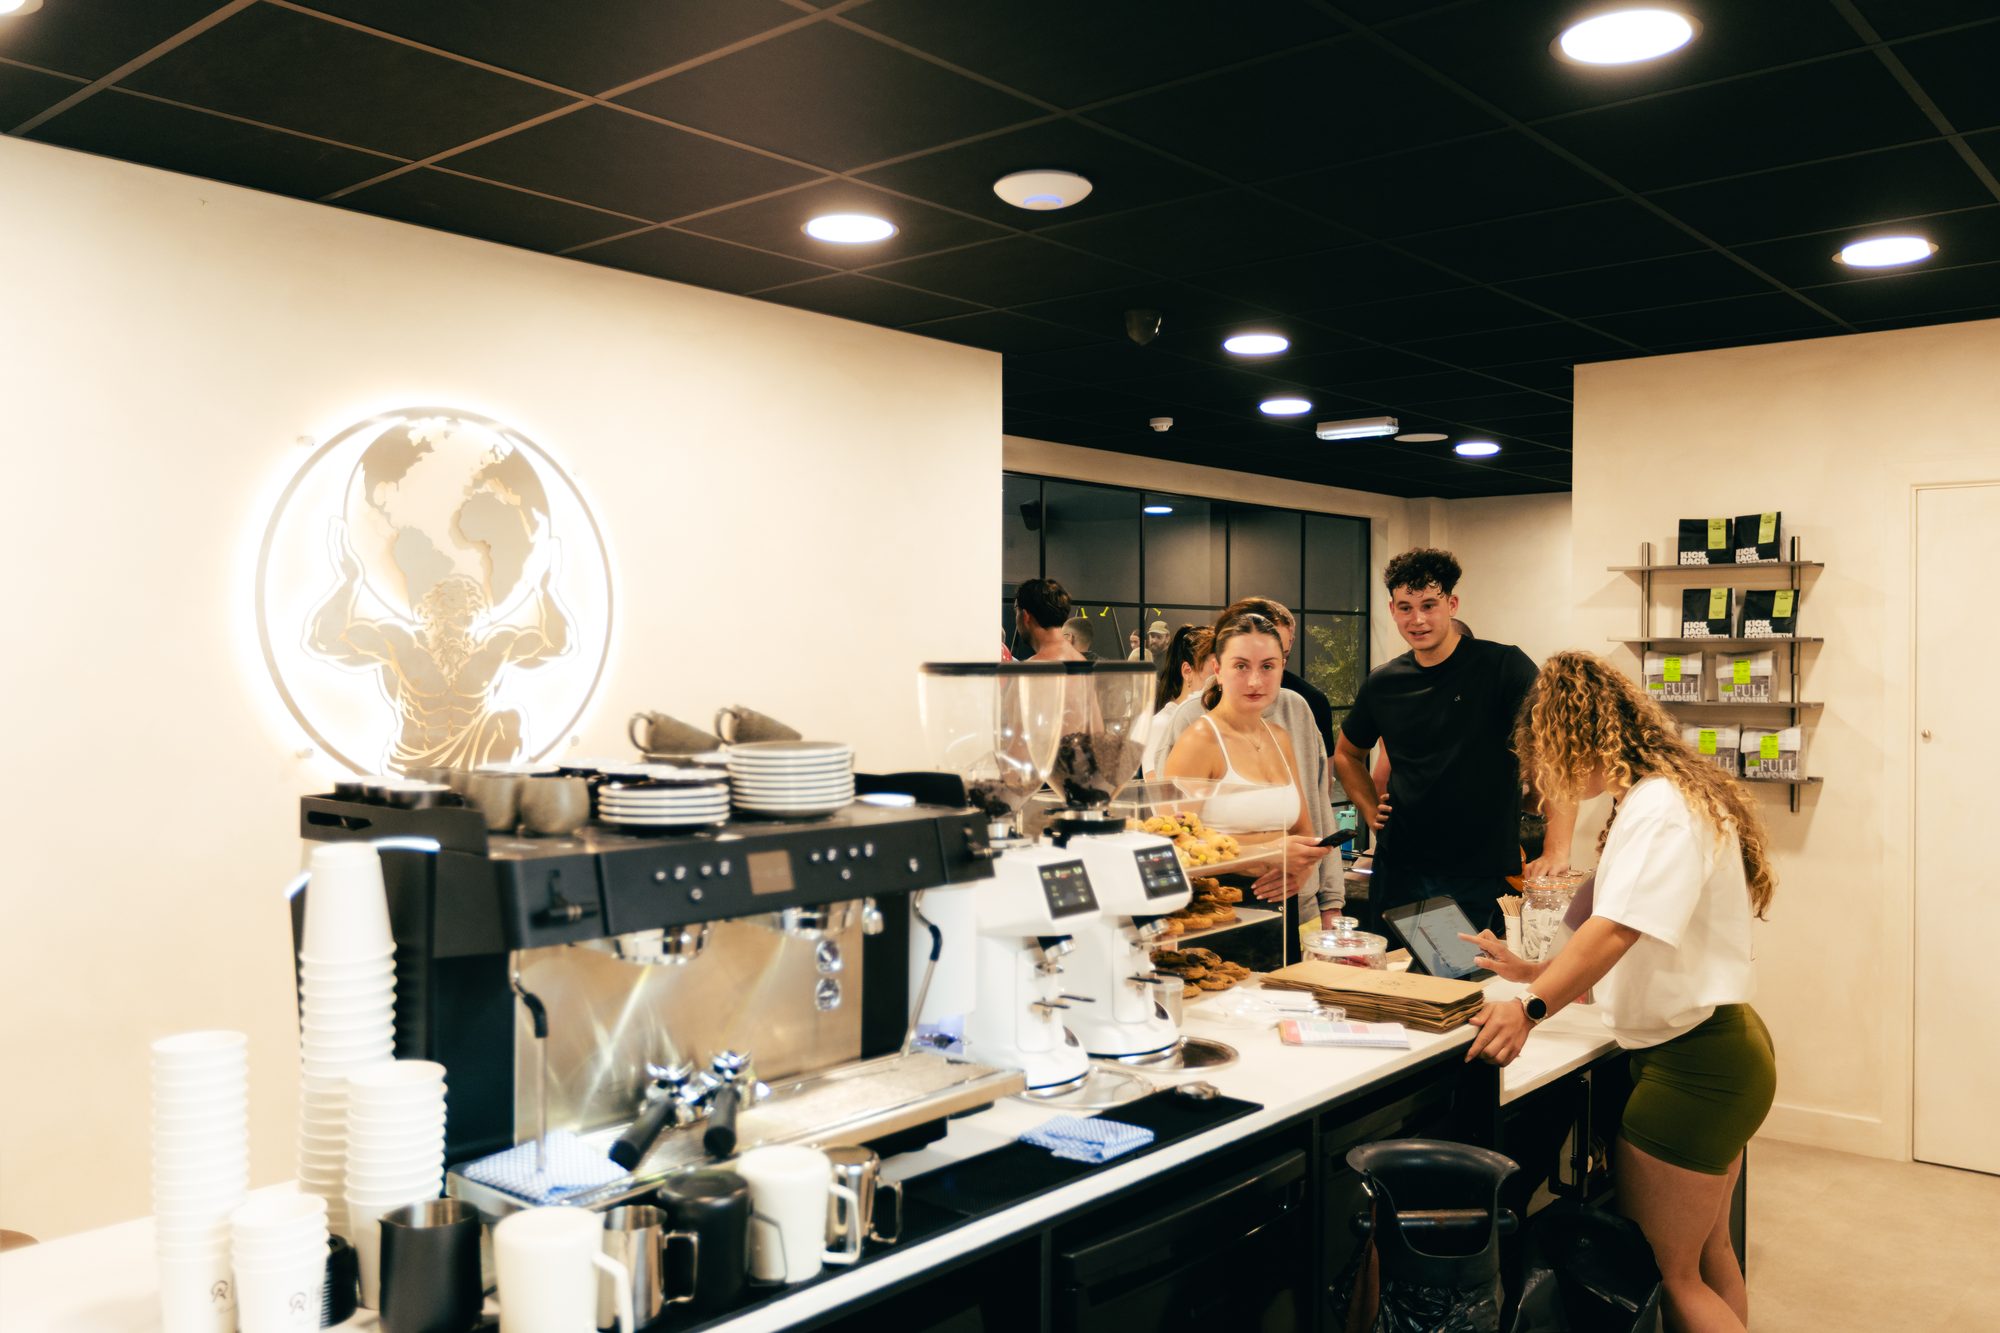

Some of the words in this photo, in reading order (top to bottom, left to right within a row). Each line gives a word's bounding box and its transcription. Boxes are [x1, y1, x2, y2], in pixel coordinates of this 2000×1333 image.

[1736, 547, 1757, 557] KICK
[1736, 553, 1760, 562] BACK
[1744, 626, 1772, 634] BACK
[1664, 683, 1698, 695] FULL
[1734, 684, 1768, 697] FULL
[1760, 759, 1796, 772] FULL
